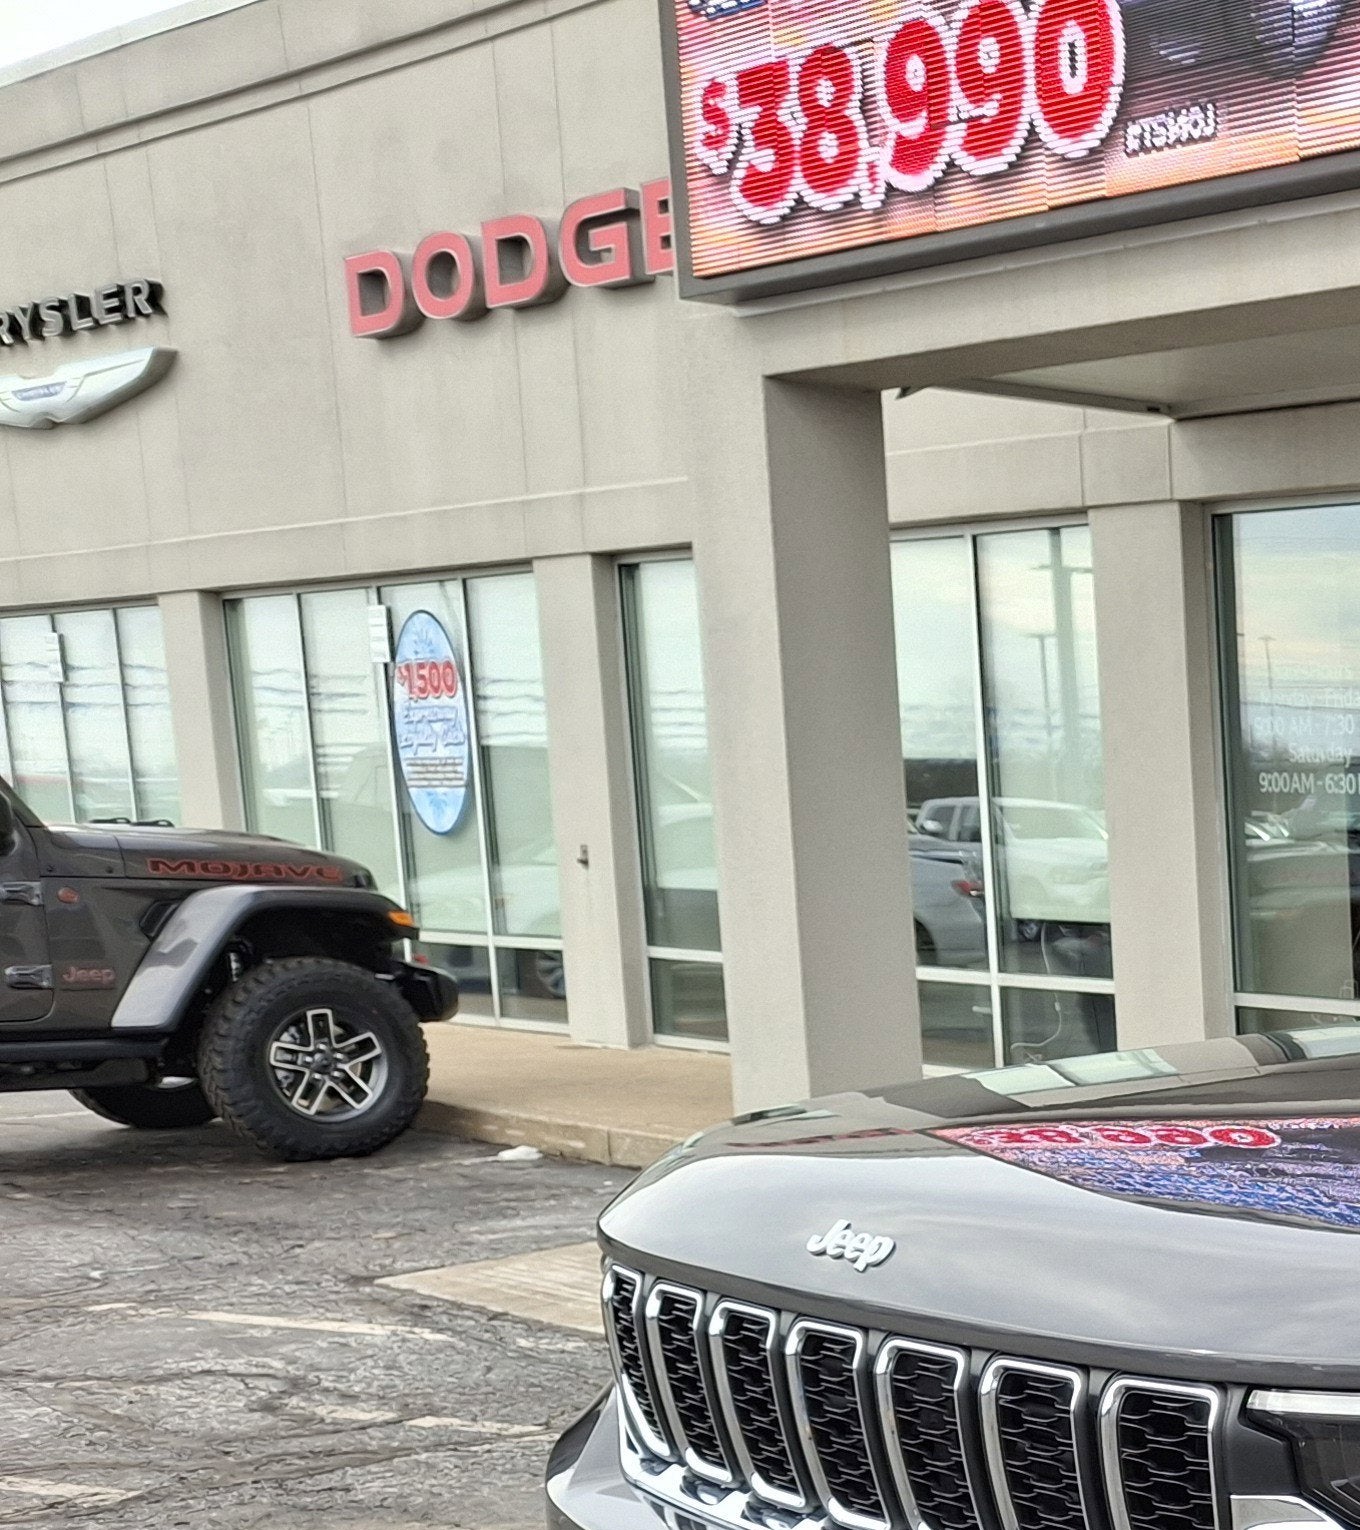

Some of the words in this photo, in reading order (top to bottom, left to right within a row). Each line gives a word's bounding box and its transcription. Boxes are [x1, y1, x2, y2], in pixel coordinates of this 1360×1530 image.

[696, 0, 1126, 226] $38,990
[146, 858, 344, 884] MOJAVE
[61, 965, 116, 986] Jeep
[806, 1219, 896, 1273] Jeep
